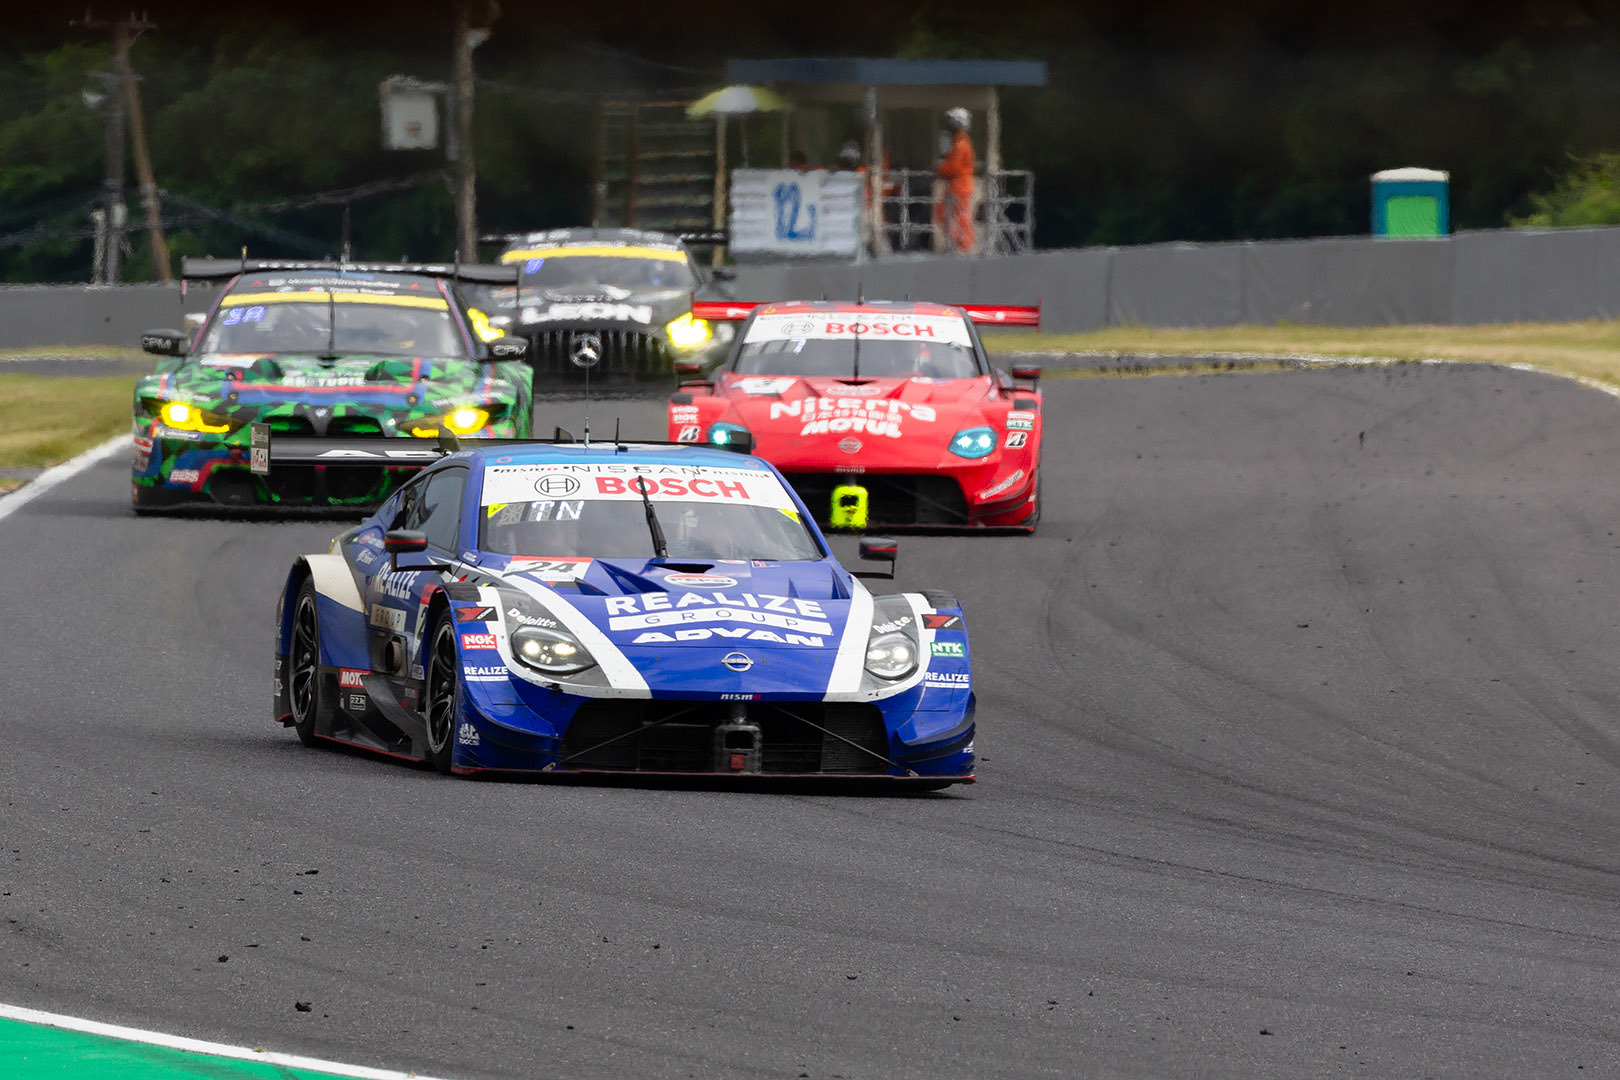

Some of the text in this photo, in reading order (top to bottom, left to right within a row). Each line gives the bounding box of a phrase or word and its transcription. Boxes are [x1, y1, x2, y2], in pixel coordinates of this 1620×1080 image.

[825, 322, 935, 337] BOSCH
[771, 397, 936, 422] Niterra
[800, 417, 903, 438] MOTUL
[572, 464, 703, 479] NISSAN
[595, 475, 752, 500] BOSCH
[502, 561, 578, 578] 24
[604, 591, 829, 620] REALIZE
[644, 610, 800, 627] GROUP
[464, 635, 496, 645] NGK
[632, 628, 825, 647] ADVAN
[931, 642, 963, 653] NTK
[463, 666, 509, 675] REALIZE
[925, 672, 969, 682] REALIZE
